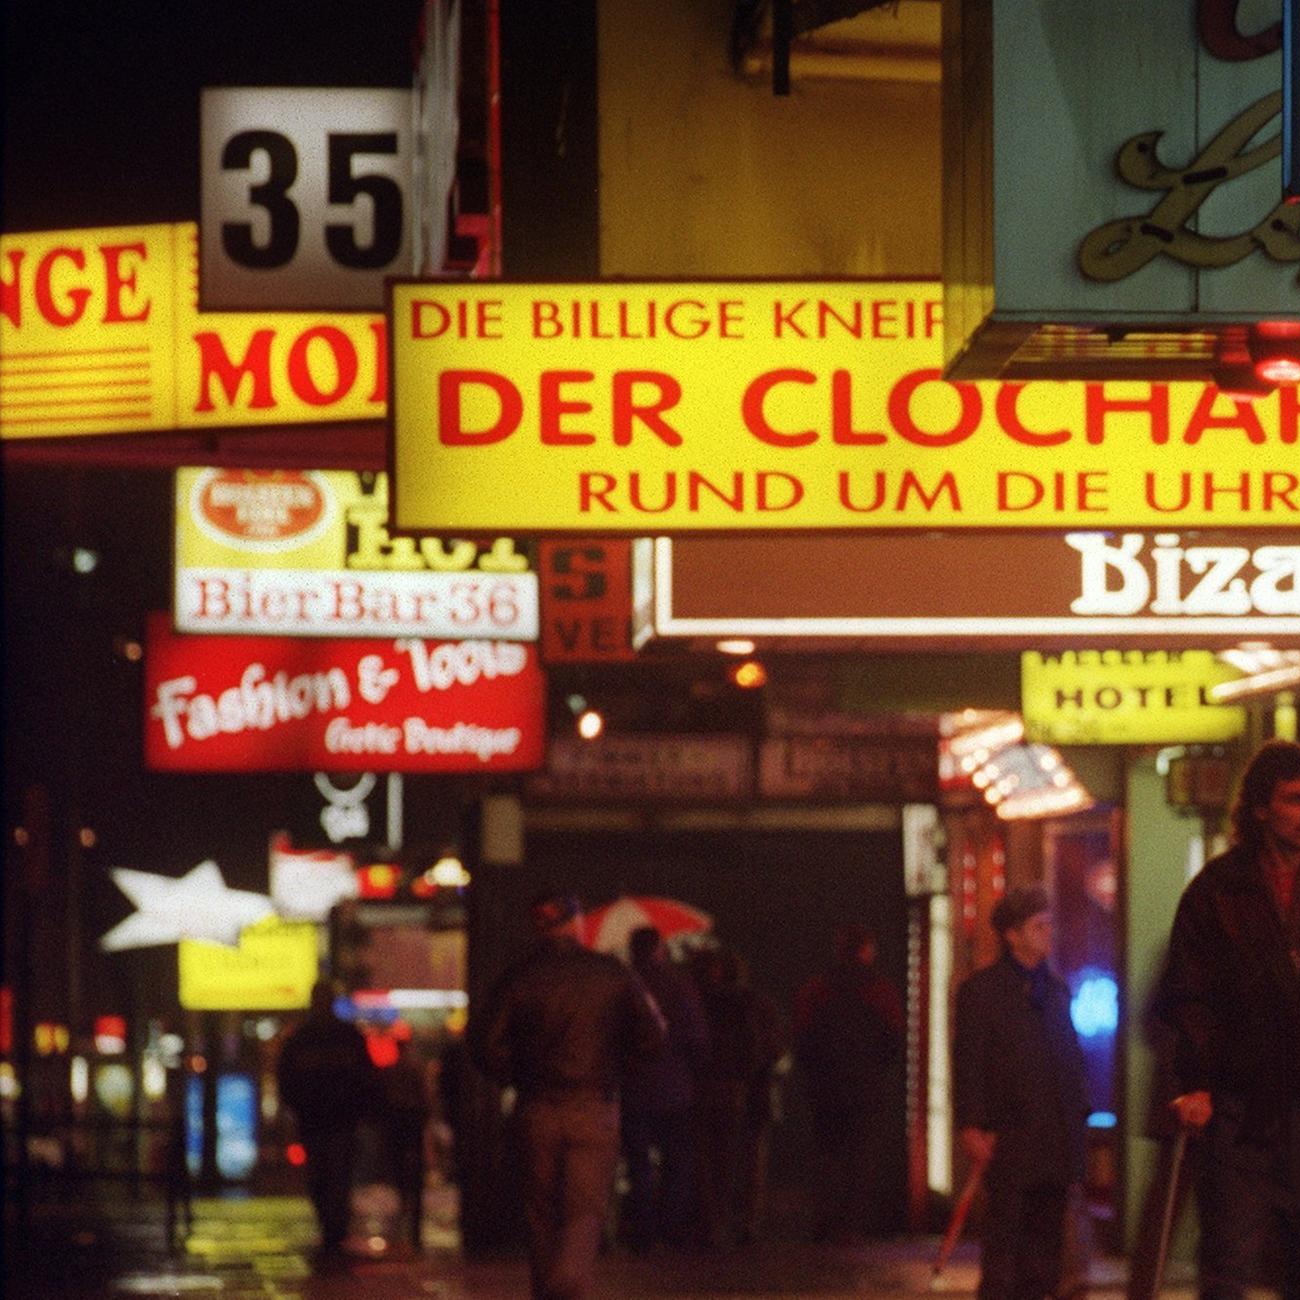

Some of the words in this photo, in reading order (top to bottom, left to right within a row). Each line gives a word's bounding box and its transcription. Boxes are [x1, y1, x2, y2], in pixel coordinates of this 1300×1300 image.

[220, 130, 402, 271] 35
[409, 299, 503, 339] DIE
[532, 299, 745, 339] BILLIGE
[193, 321, 386, 413] MO
[437, 369, 683, 447] DER
[579, 471, 805, 512] RUND
[837, 471, 963, 512] UM
[997, 471, 1109, 512] DIE
[1146, 471, 1300, 512] UHR
[449, 582, 521, 627] 36
[151, 663, 350, 749] Fashion
[358, 654, 399, 704] &
[1055, 686, 1216, 709] HOTEL
